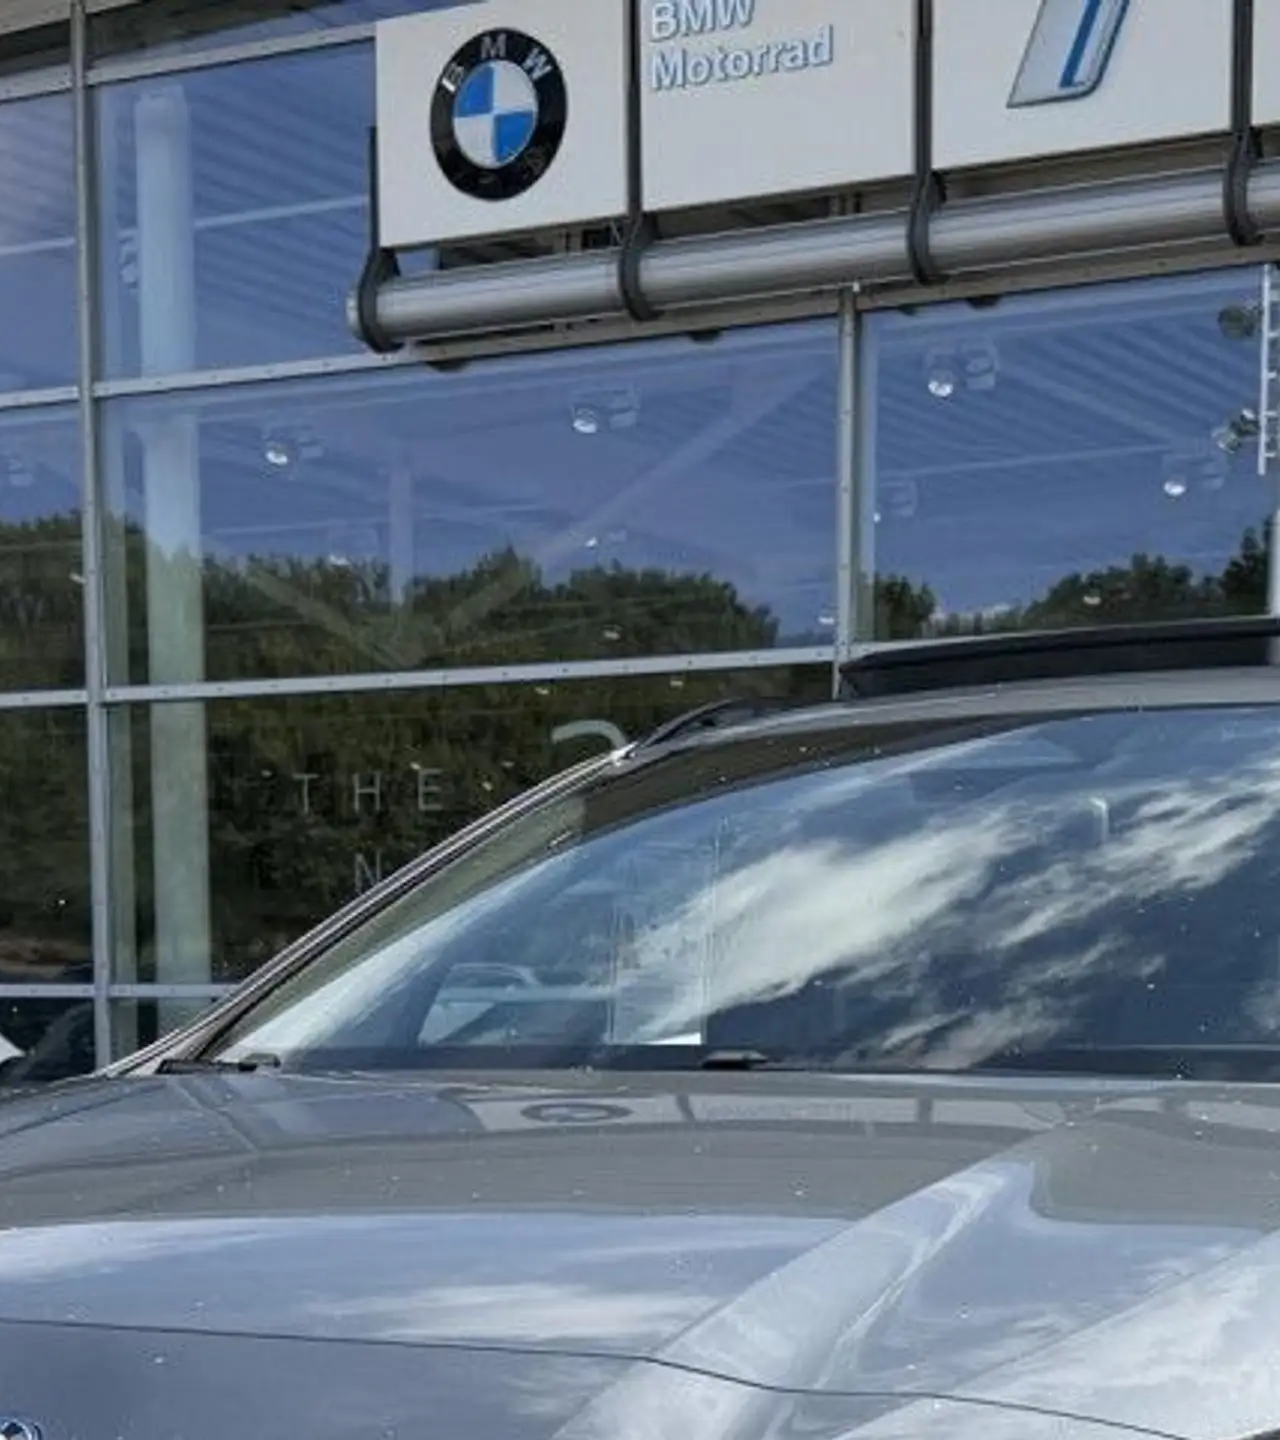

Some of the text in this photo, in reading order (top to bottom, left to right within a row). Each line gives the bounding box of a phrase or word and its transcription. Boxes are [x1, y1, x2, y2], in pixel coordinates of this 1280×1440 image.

[652, 0, 754, 41] BMW
[442, 33, 553, 93] BMW
[651, 24, 833, 91] Motorrad
